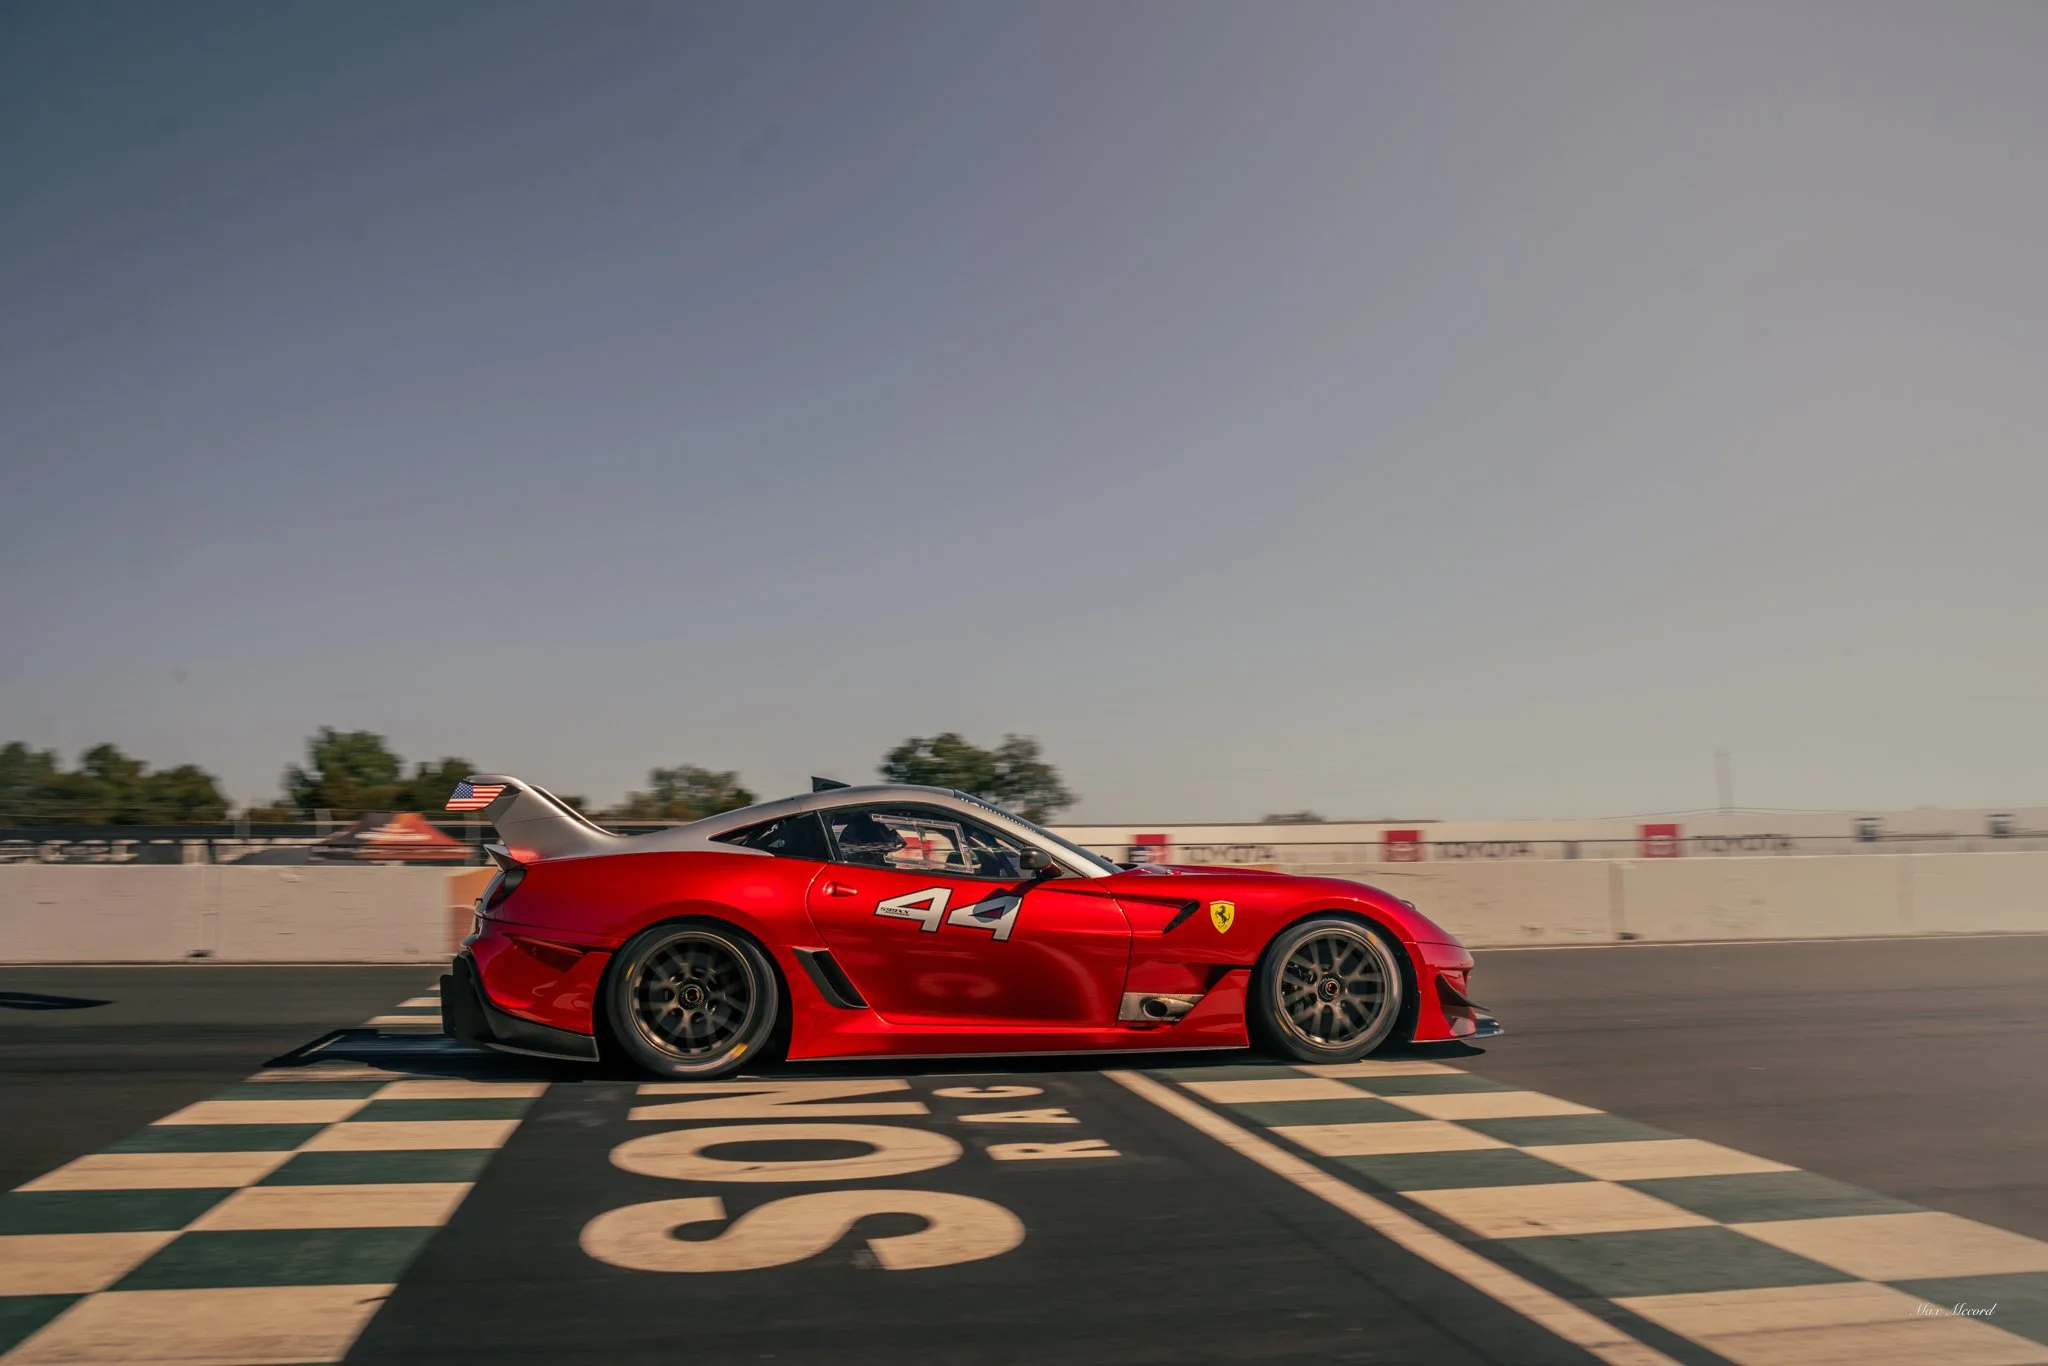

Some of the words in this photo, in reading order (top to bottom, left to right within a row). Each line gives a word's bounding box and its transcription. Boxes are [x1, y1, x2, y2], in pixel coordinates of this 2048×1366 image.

[873, 886, 1024, 942] 44
[931, 1075, 1123, 1161] RAC
[578, 1076, 1026, 1273] SON
